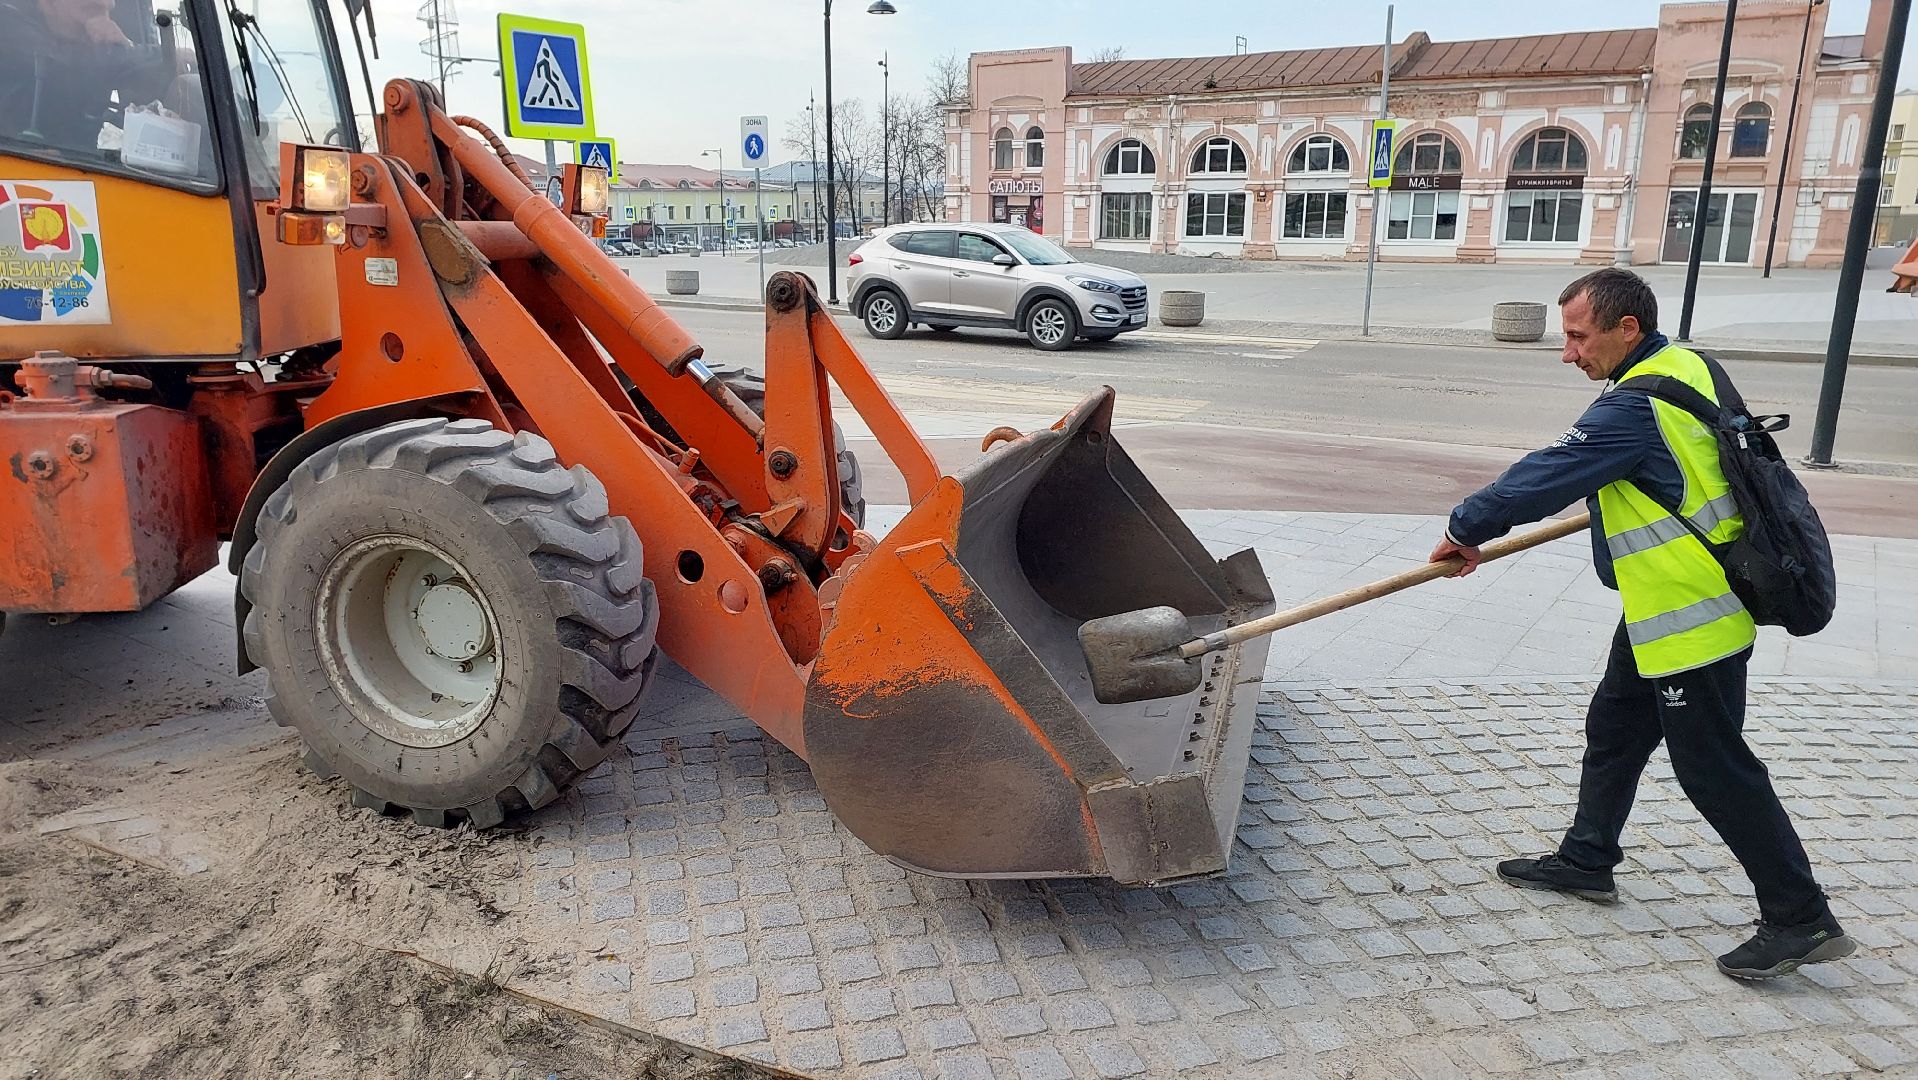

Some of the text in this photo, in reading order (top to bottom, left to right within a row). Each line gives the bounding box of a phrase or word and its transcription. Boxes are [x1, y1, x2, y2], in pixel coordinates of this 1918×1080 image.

[745, 118, 762, 126] ЗОНА
[988, 180, 1043, 193] САЛЮТЫ
[1408, 177, 1440, 188] MALE
